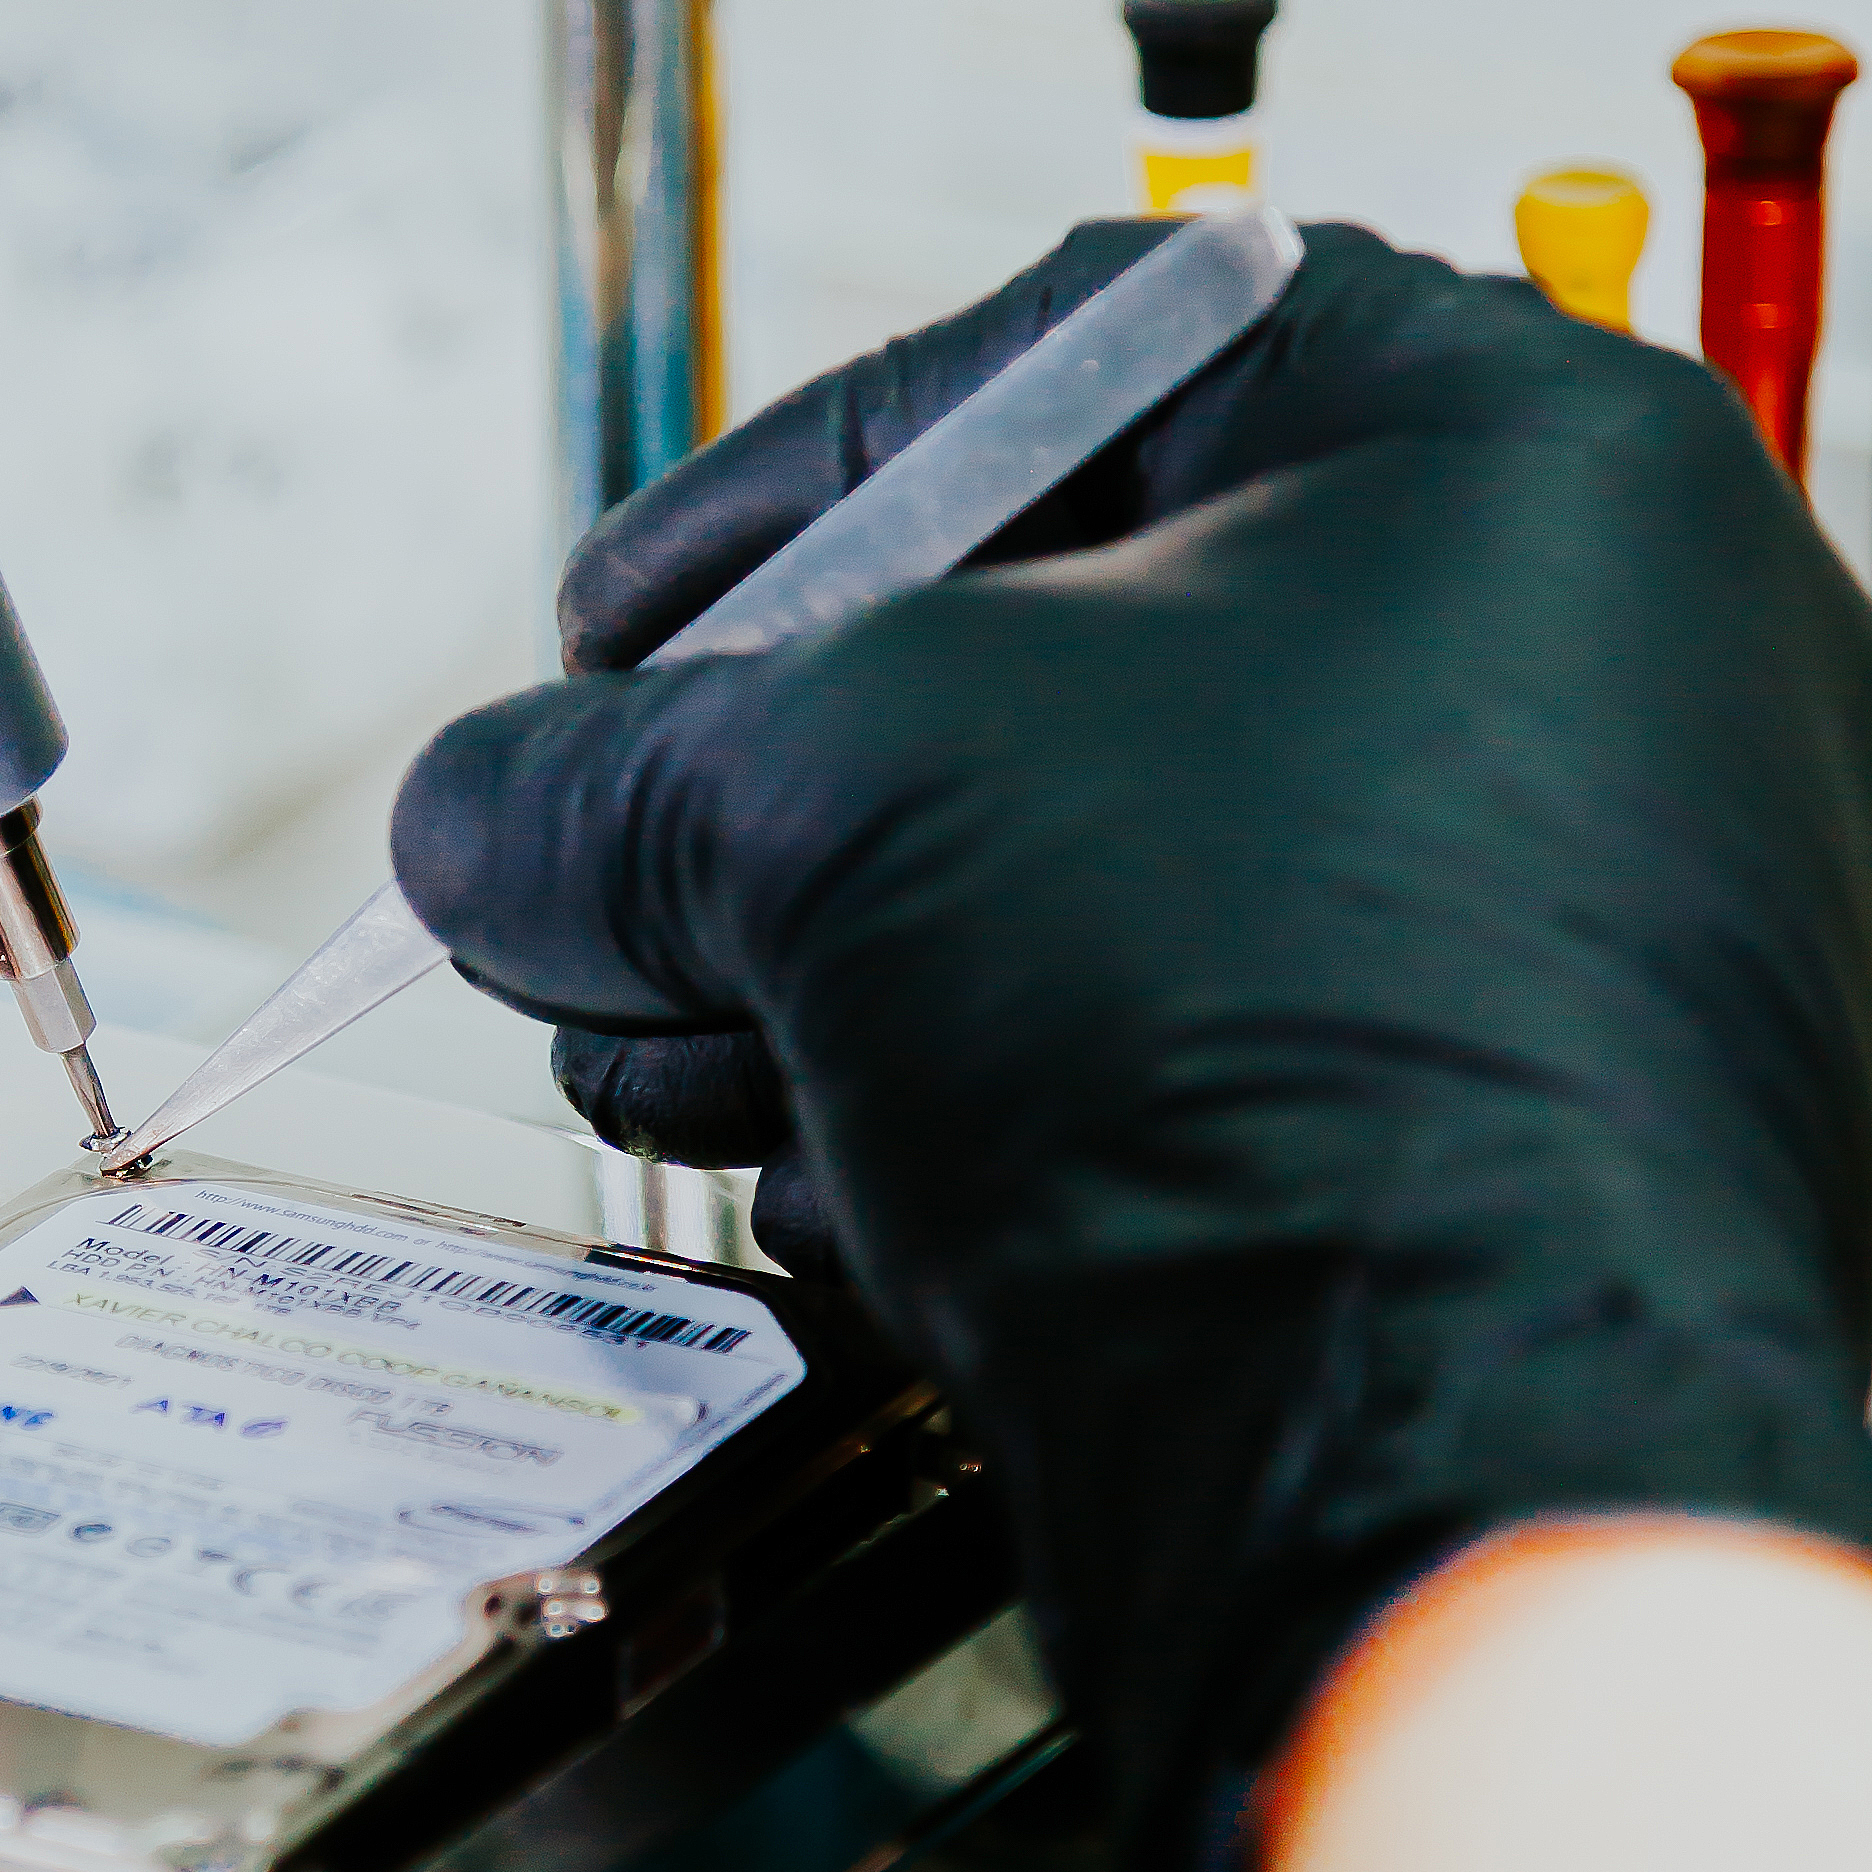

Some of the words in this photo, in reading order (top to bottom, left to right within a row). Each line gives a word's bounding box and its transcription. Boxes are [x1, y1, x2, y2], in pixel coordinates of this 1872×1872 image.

[194, 1189, 408, 1243] http://www.samsunghdd.com
[61, 1249, 121, 1266] HDD
[78, 1237, 174, 1263] Model
[69, 1293, 188, 1326] XAVIER
[191, 1320, 335, 1359] CHALCO
